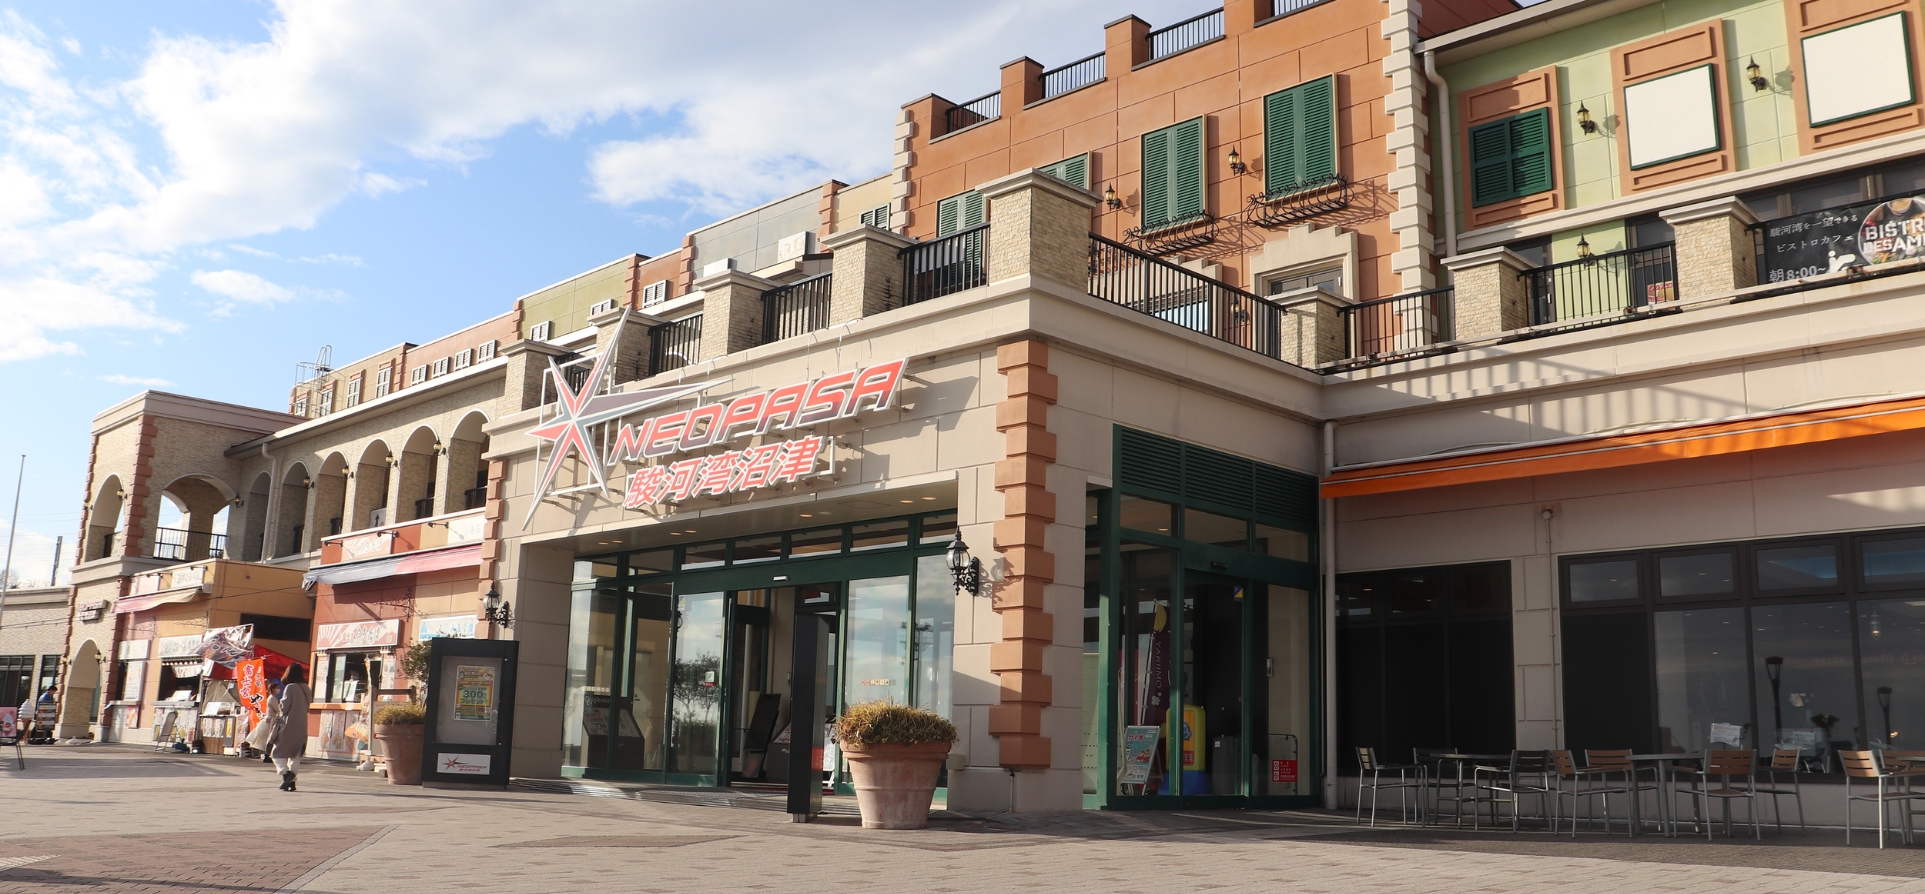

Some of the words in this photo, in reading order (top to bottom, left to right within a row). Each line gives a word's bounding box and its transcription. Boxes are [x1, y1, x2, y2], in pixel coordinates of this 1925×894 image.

[1769, 214, 1858, 238] 駿河湾を一望できる
[1777, 235, 1854, 253] ビストロカフェ
[608, 357, 909, 466] NEOPASA
[623, 435, 825, 509] 駿河湾沼津
